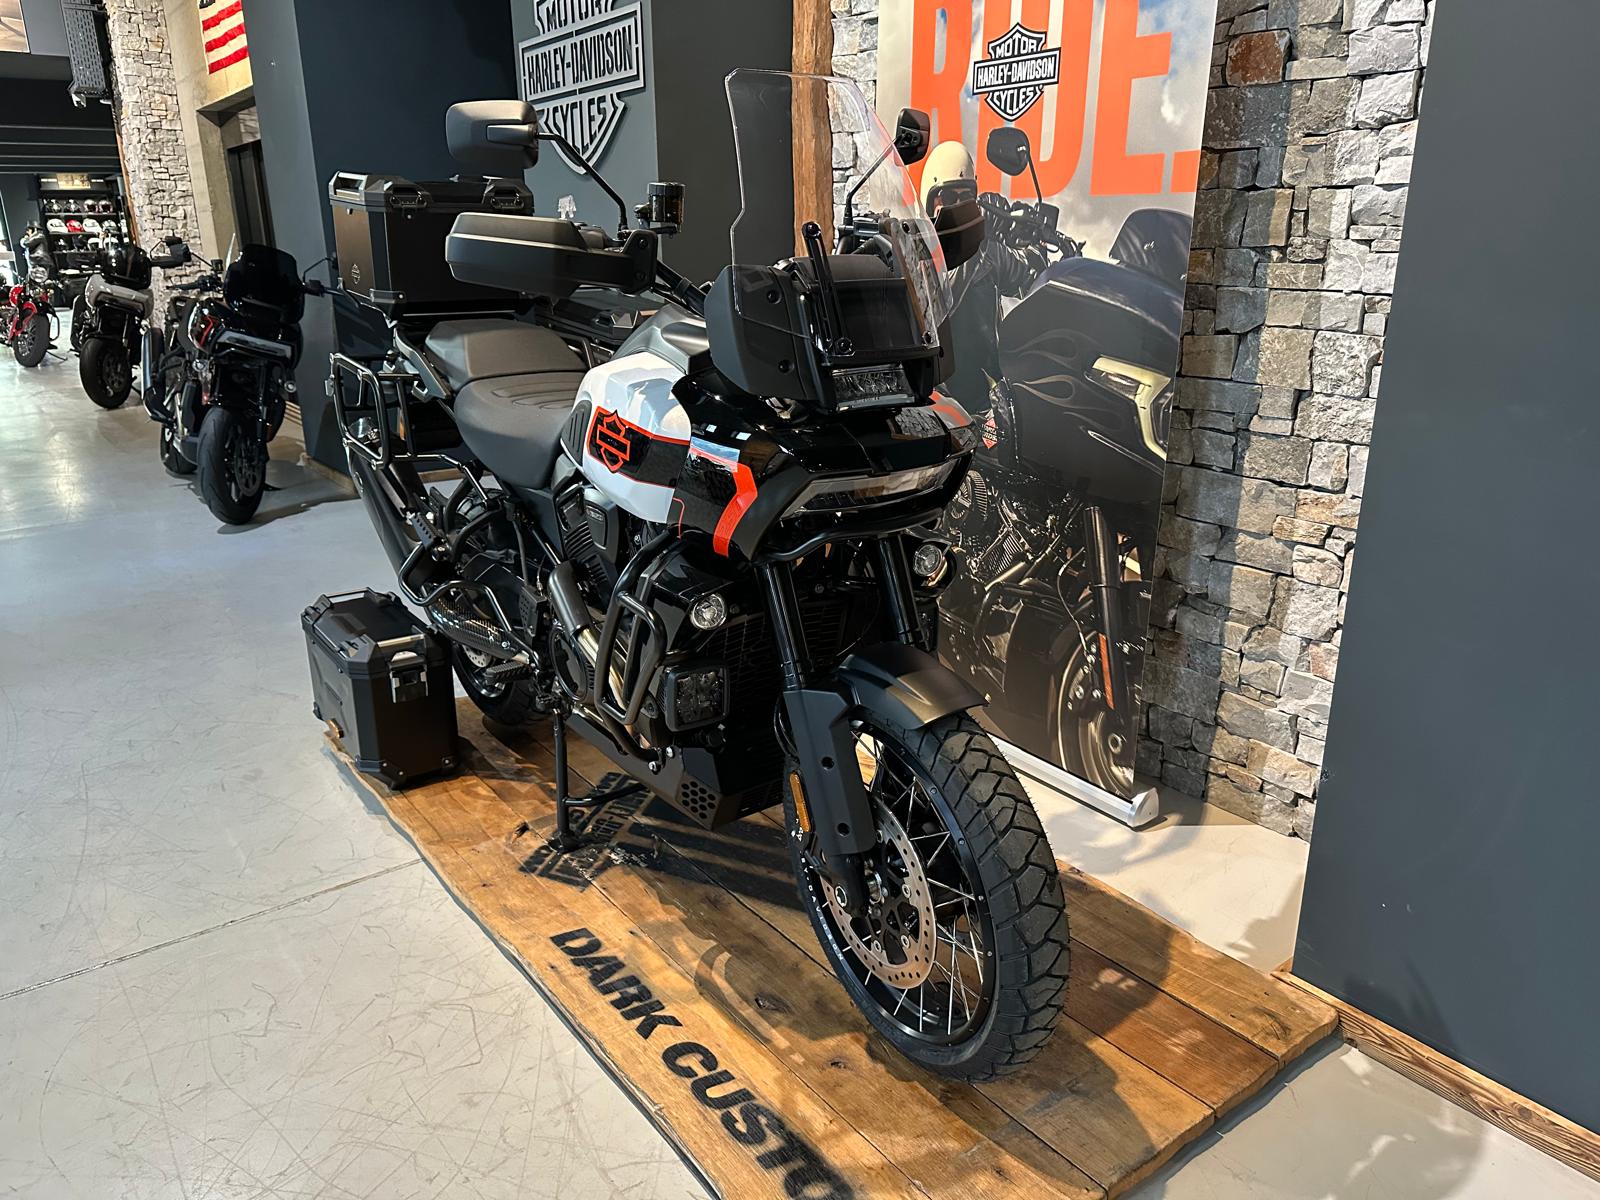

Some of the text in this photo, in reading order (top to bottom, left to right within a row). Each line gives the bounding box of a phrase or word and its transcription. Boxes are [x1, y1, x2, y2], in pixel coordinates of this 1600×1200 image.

[527, 25, 633, 95] HARLEY-DAVIDSON
[996, 32, 1037, 58] MOTOR
[977, 57, 1055, 87] HARLEY-DAVIDSON
[993, 87, 1034, 115] CYCLES
[552, 95, 607, 156] CYCLES
[549, 928, 683, 1039] DARK
